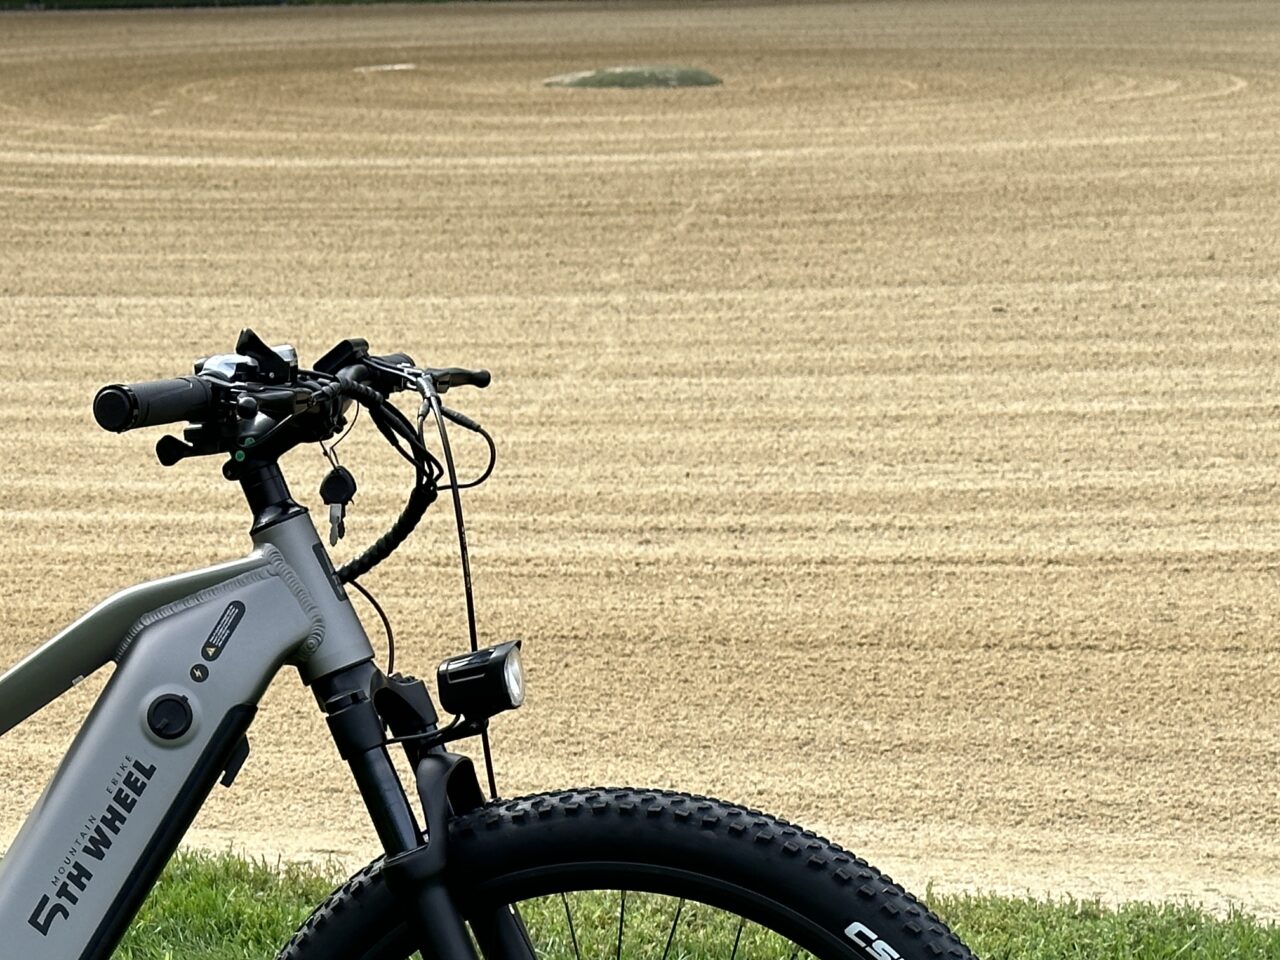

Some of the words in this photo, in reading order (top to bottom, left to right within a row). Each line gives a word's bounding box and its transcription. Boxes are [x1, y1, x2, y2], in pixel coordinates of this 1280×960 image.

[27, 860, 94, 937] 5TH
[81, 759, 157, 861] WHEEL
[51, 814, 97, 887] MOUNTAIN
[106, 754, 132, 795] EBIKE
